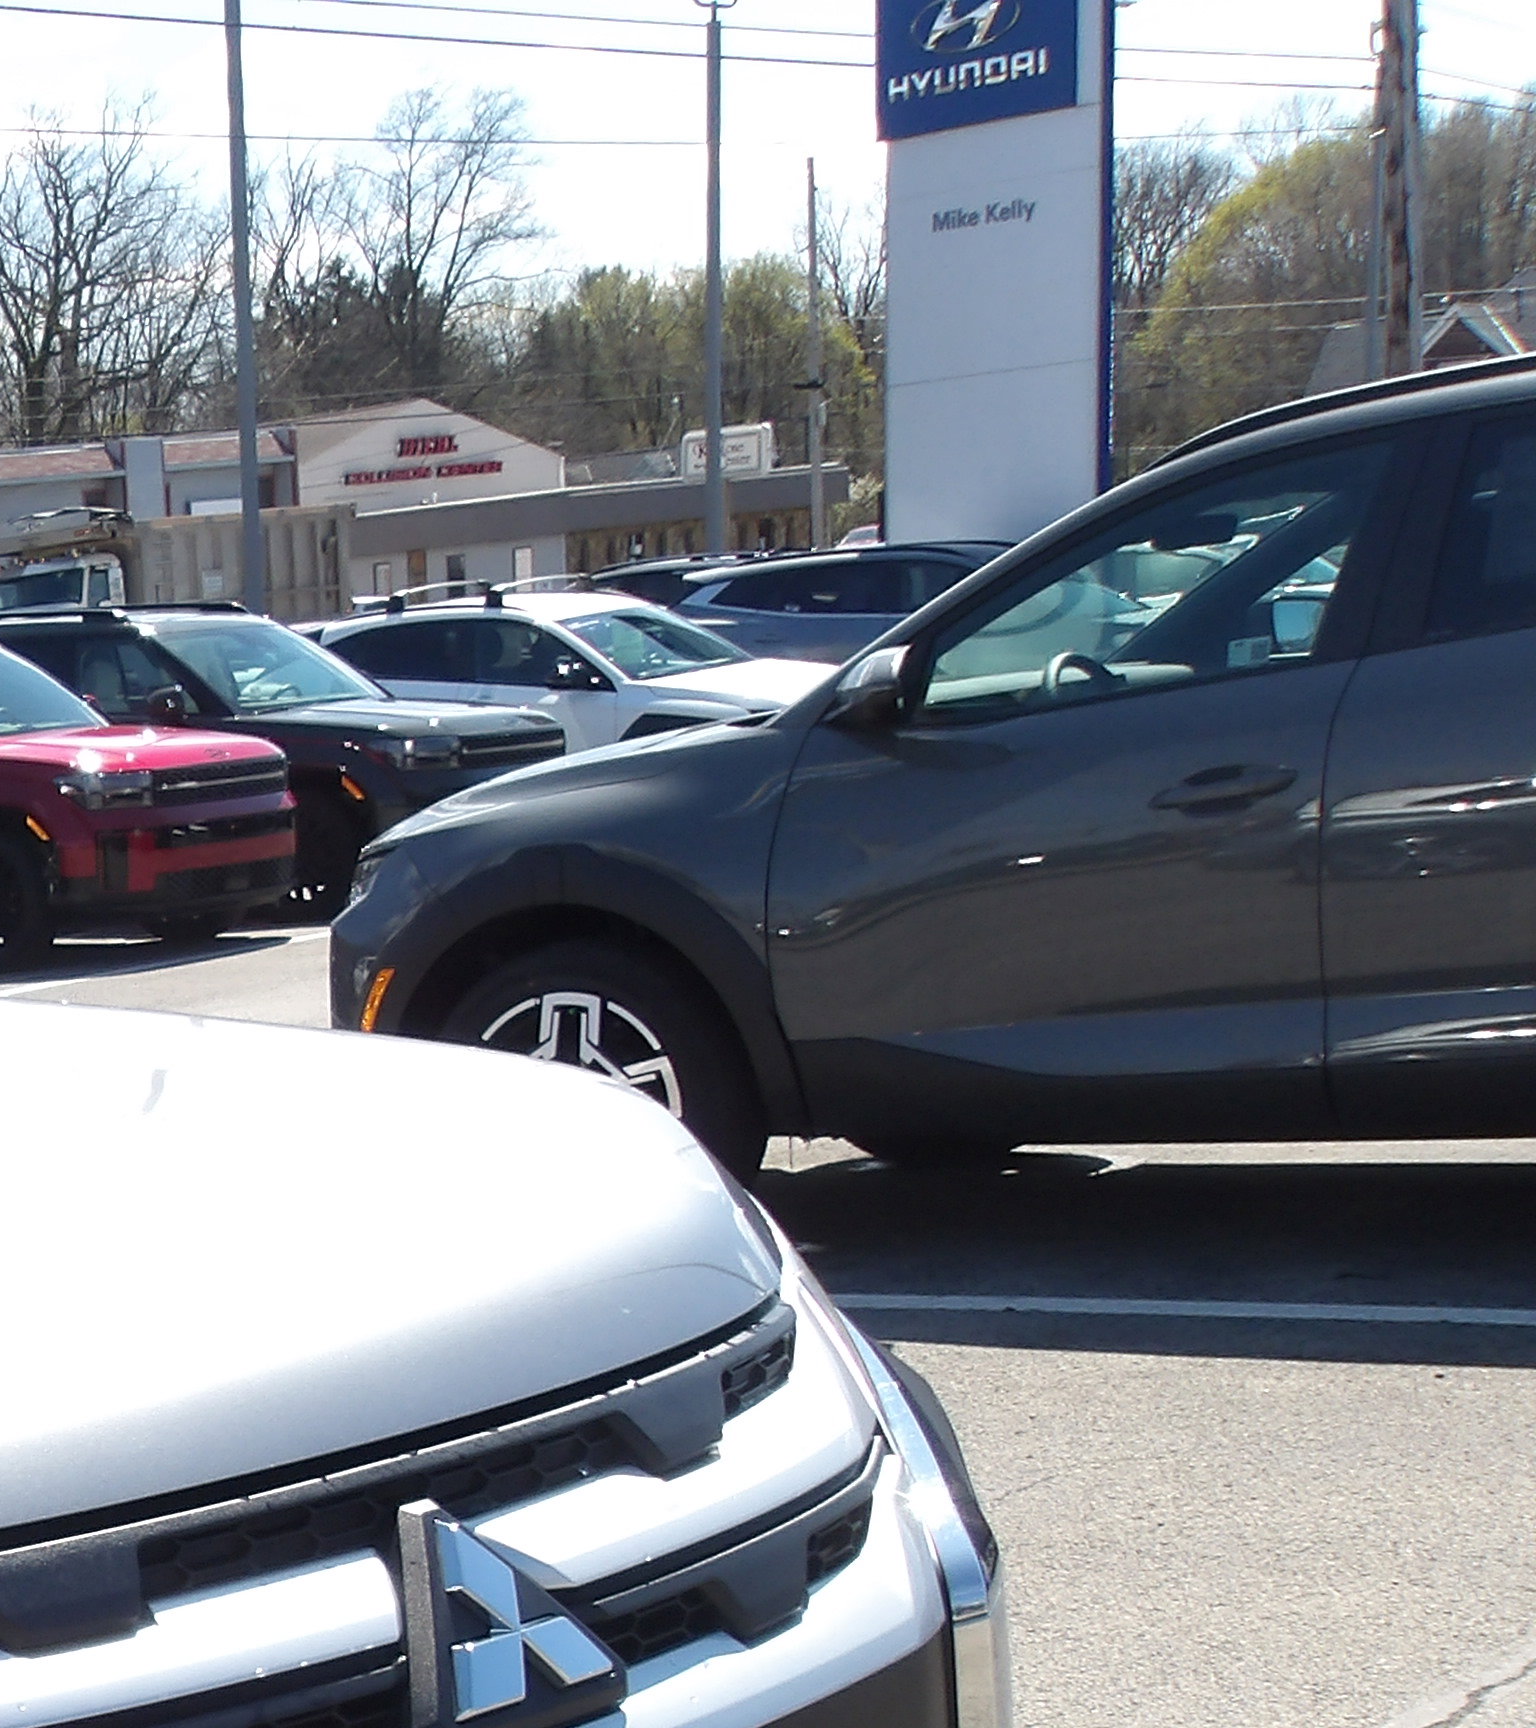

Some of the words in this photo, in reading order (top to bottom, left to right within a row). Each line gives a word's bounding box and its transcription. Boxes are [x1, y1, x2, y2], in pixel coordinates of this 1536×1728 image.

[888, 46, 1050, 104] HYUNDAI
[931, 207, 979, 233] Mike
[984, 199, 1037, 223] Kelly
